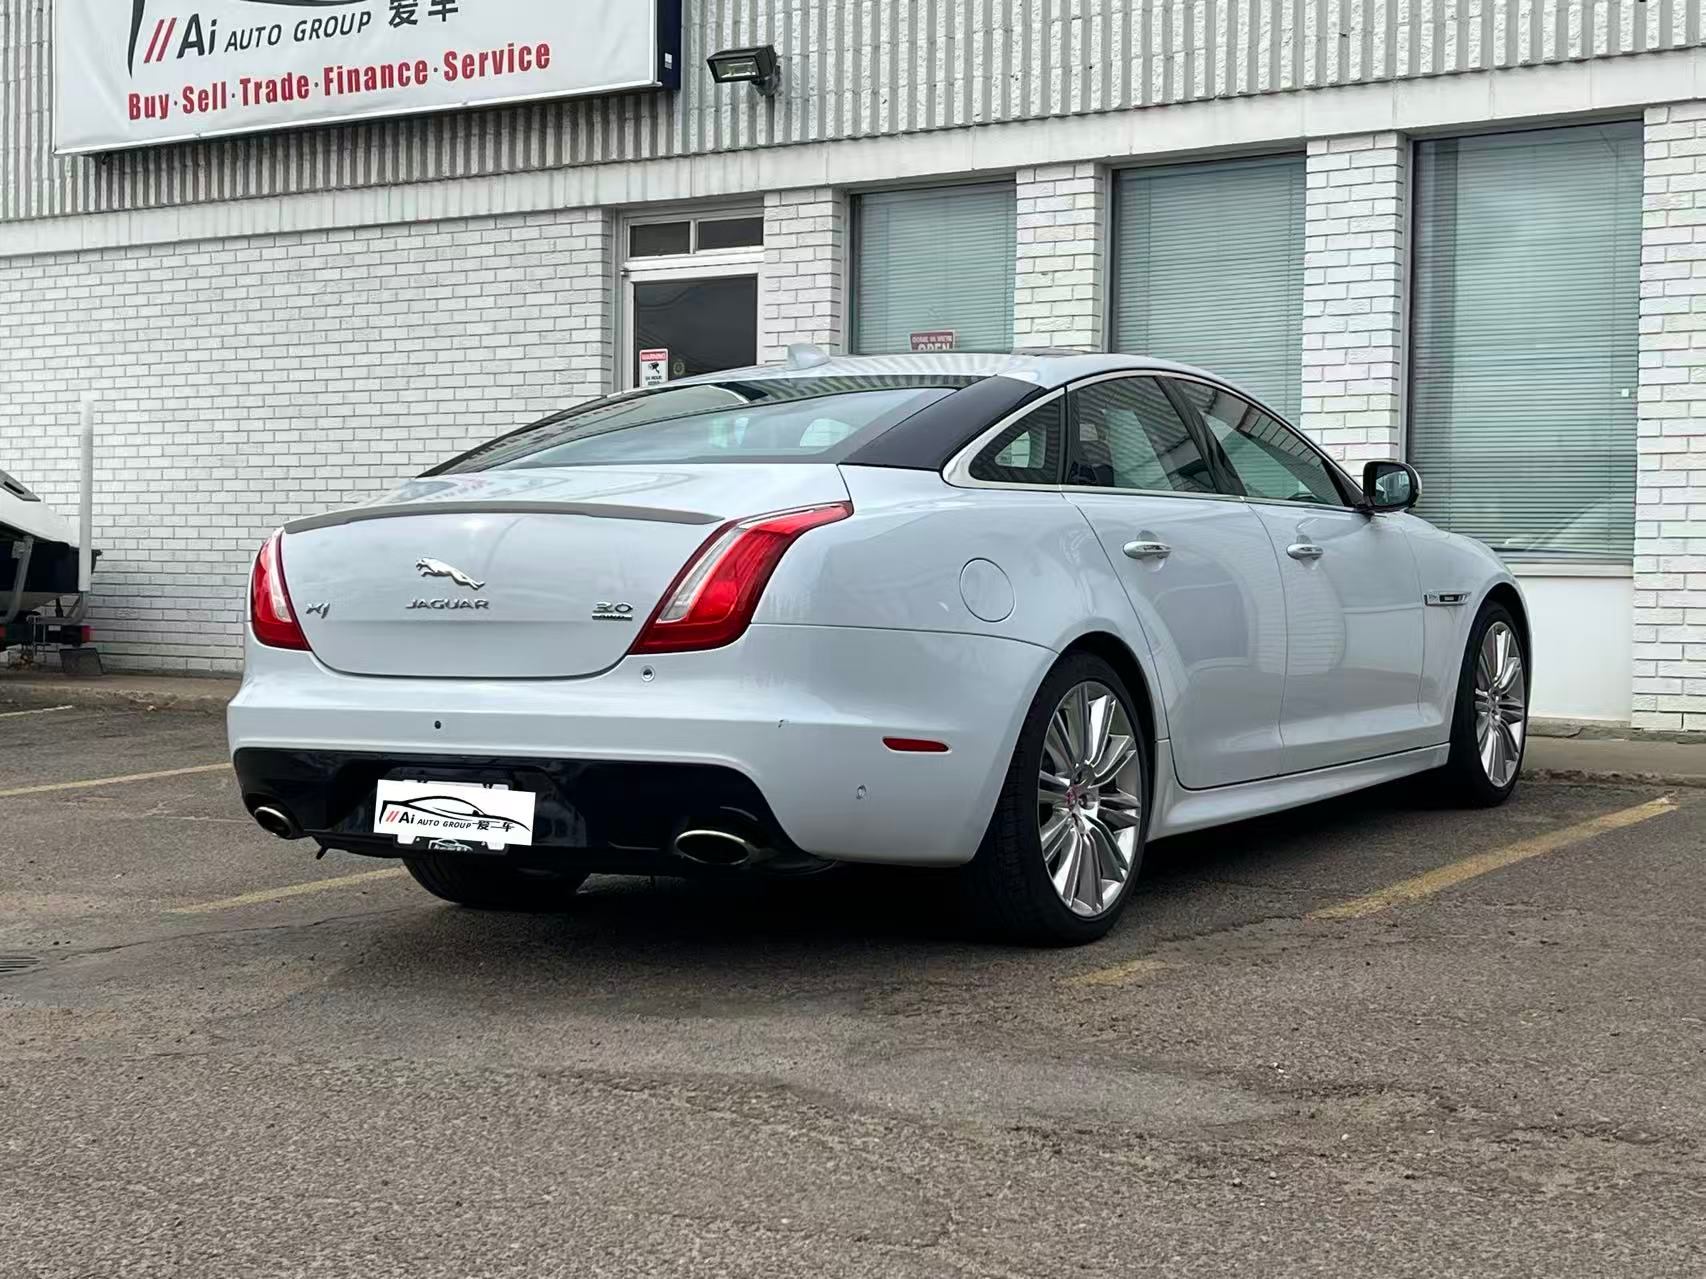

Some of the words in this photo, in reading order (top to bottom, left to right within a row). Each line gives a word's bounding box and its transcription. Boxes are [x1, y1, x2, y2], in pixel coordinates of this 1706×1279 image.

[224, 24, 282, 52] AUTO
[293, 11, 372, 43] GROUP
[128, 93, 169, 120] Buy
[182, 81, 227, 114] Sell
[239, 72, 309, 106] Trade
[323, 60, 428, 96] Finance
[443, 42, 550, 81] Service
[406, 599, 490, 610] JAGUAR
